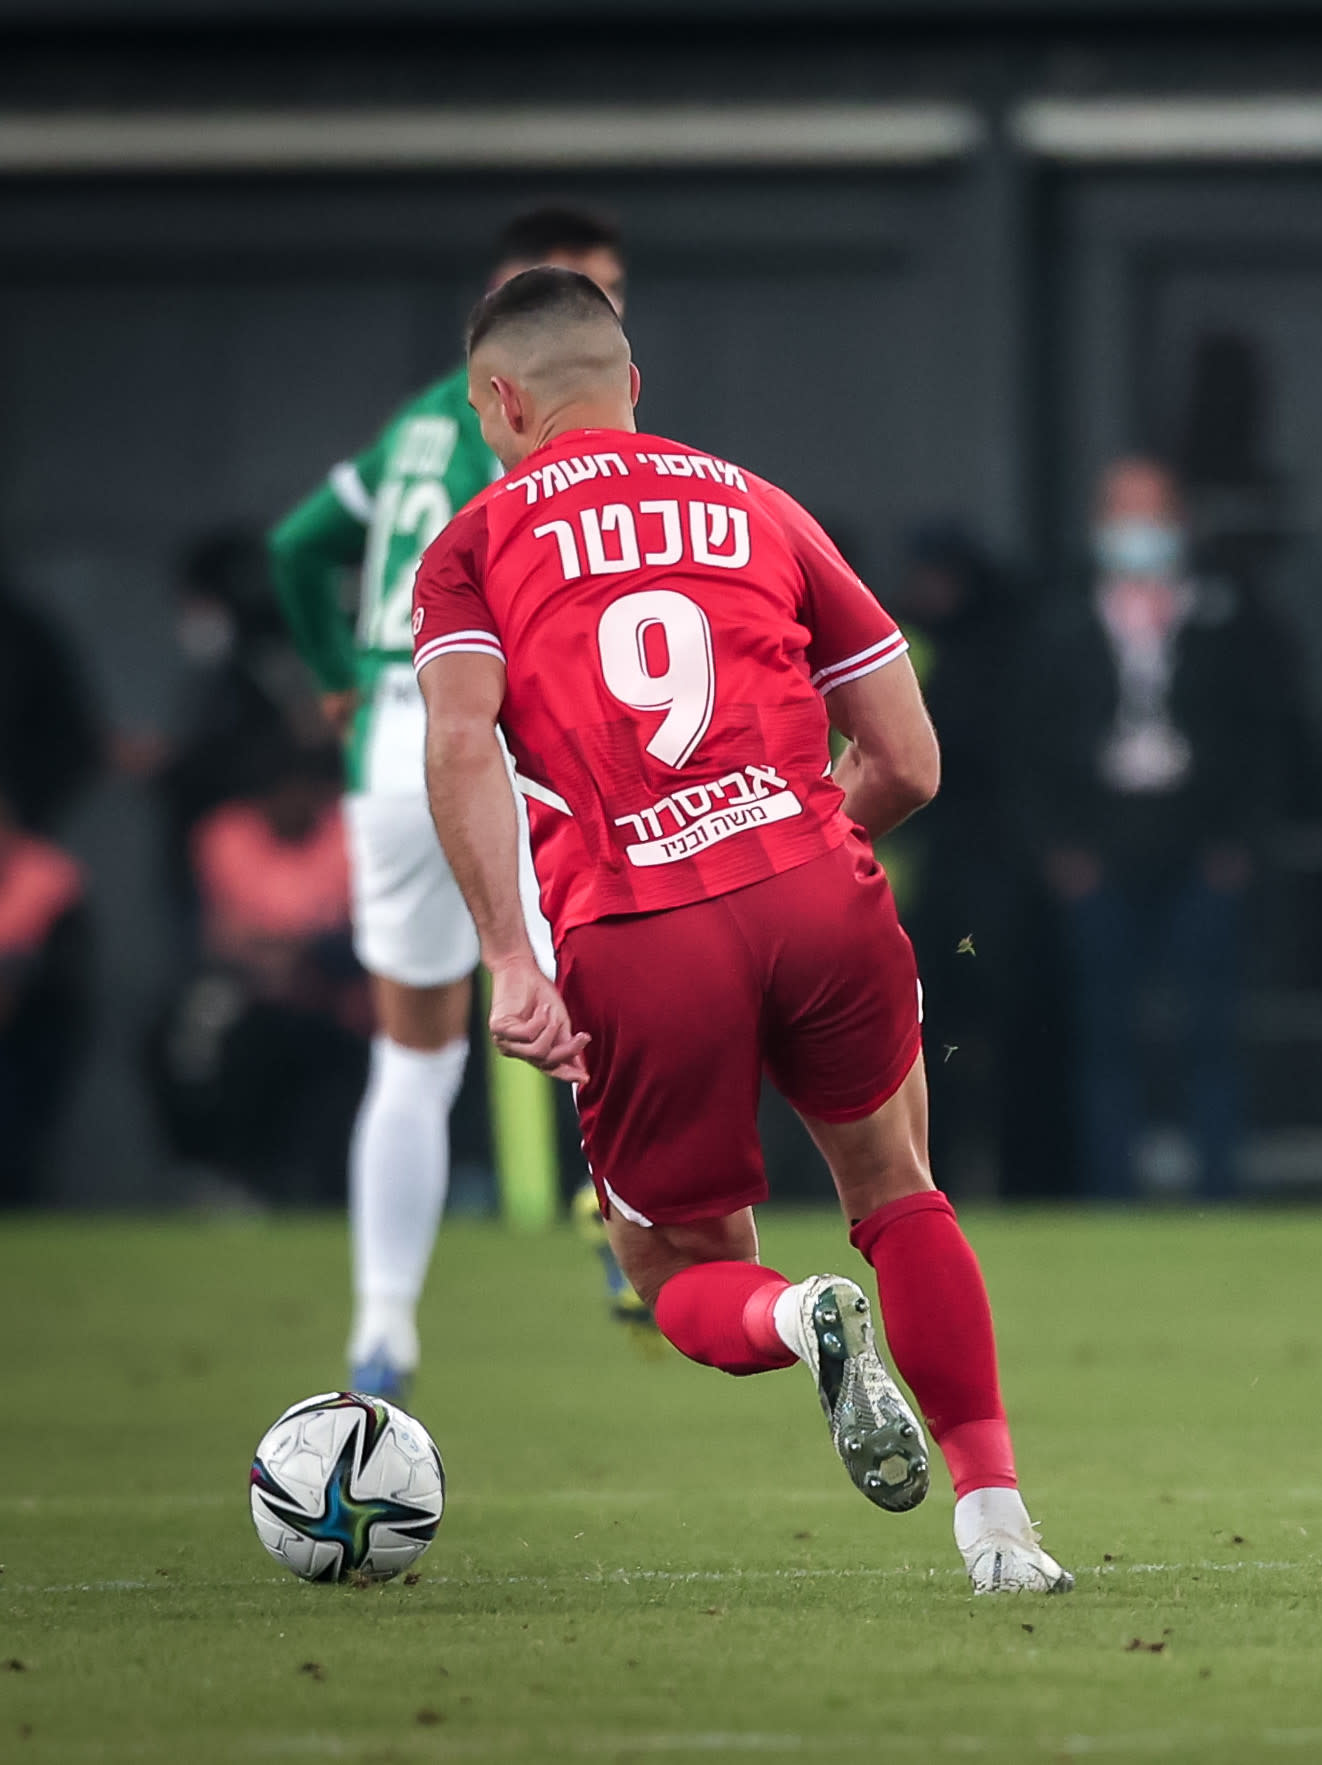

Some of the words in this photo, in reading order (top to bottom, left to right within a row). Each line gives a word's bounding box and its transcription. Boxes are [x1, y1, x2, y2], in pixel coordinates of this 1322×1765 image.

[506, 453, 629, 504] חשמל
[635, 453, 748, 493] מחסני
[533, 500, 751, 580] שכטר
[597, 589, 715, 770] 9
[614, 765, 788, 842] אביסרור
[710, 806, 767, 835] משה
[661, 826, 708, 857] ובניו
